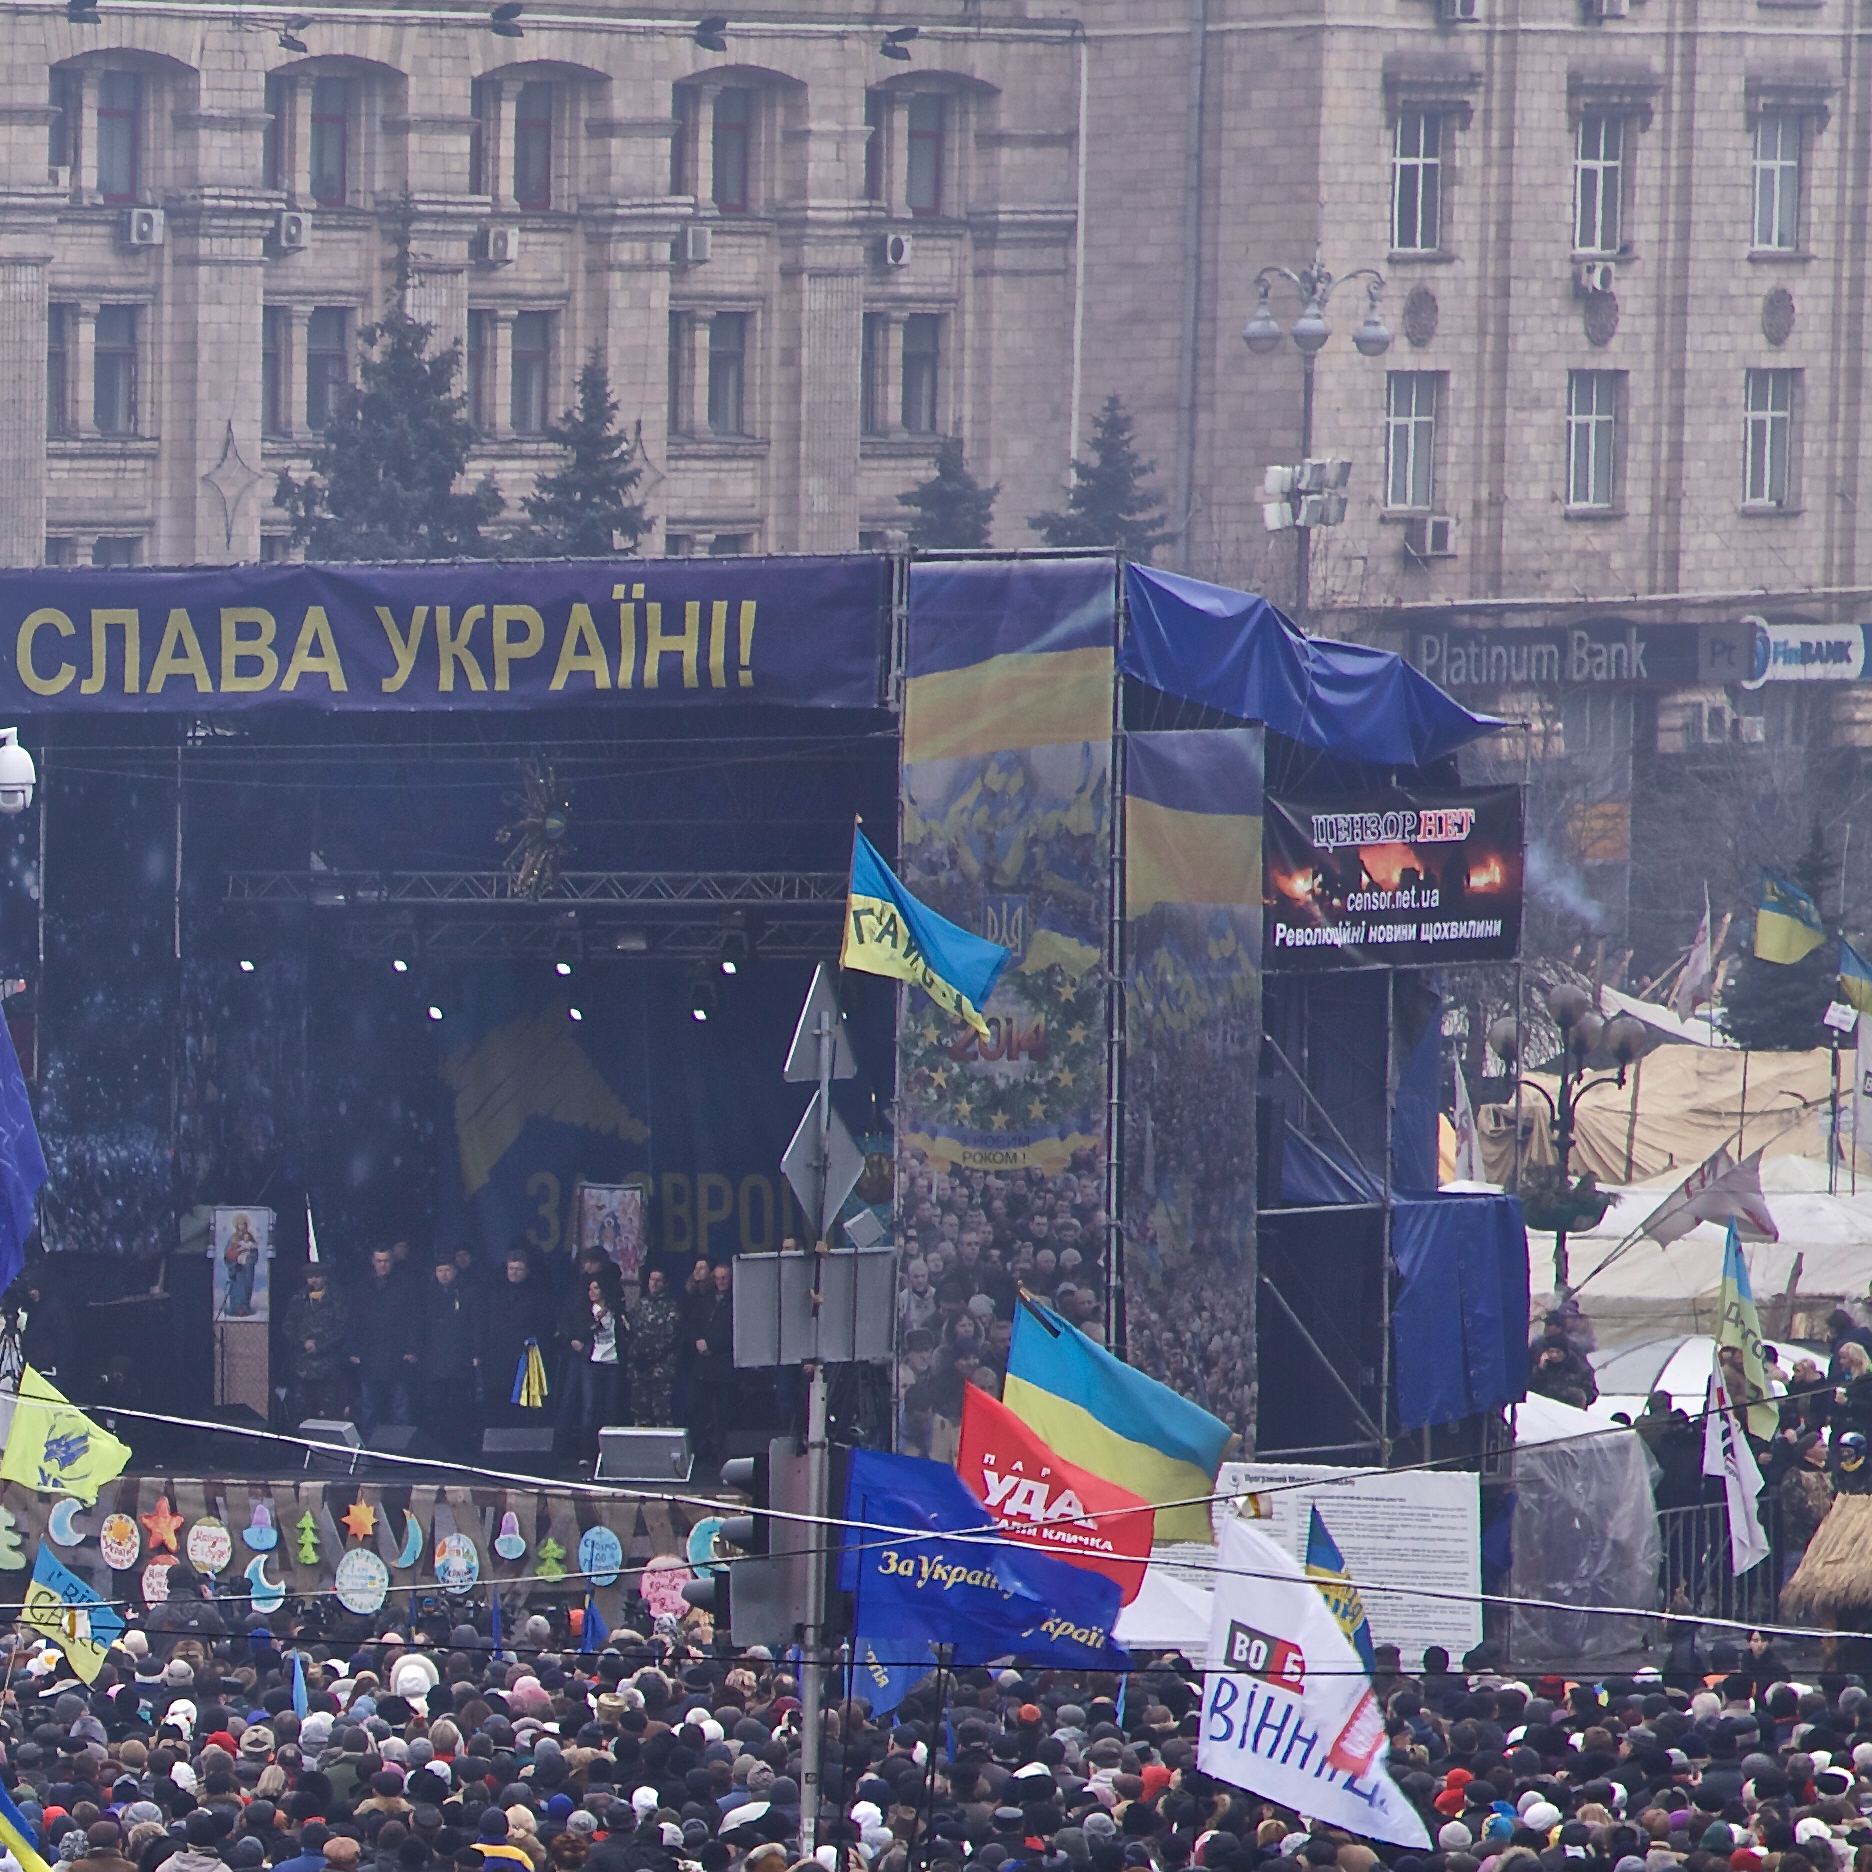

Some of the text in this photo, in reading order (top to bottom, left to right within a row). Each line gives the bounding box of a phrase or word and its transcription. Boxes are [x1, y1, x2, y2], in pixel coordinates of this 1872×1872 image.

[16, 582, 757, 696] СЛАВА УКРАЇНІ!
[1771, 638, 1853, 665] FinBANK
[1419, 628, 1648, 685] Platinum Bank
[1312, 809, 1475, 853] ЦЕНЗОР.НЕТ
[1347, 885, 1440, 911] censor.net.ua
[1275, 919, 1501, 948] Революційні новини щохвилини
[948, 1013, 1049, 1062] 2014
[972, 1135, 1030, 1149] НОВИМ
[962, 1151, 1017, 1165] РОКОМ
[1041, 1528, 1114, 1551] КЛИЧКА
[878, 1551, 913, 1577] За
[1233, 1631, 1266, 1670] ВО
